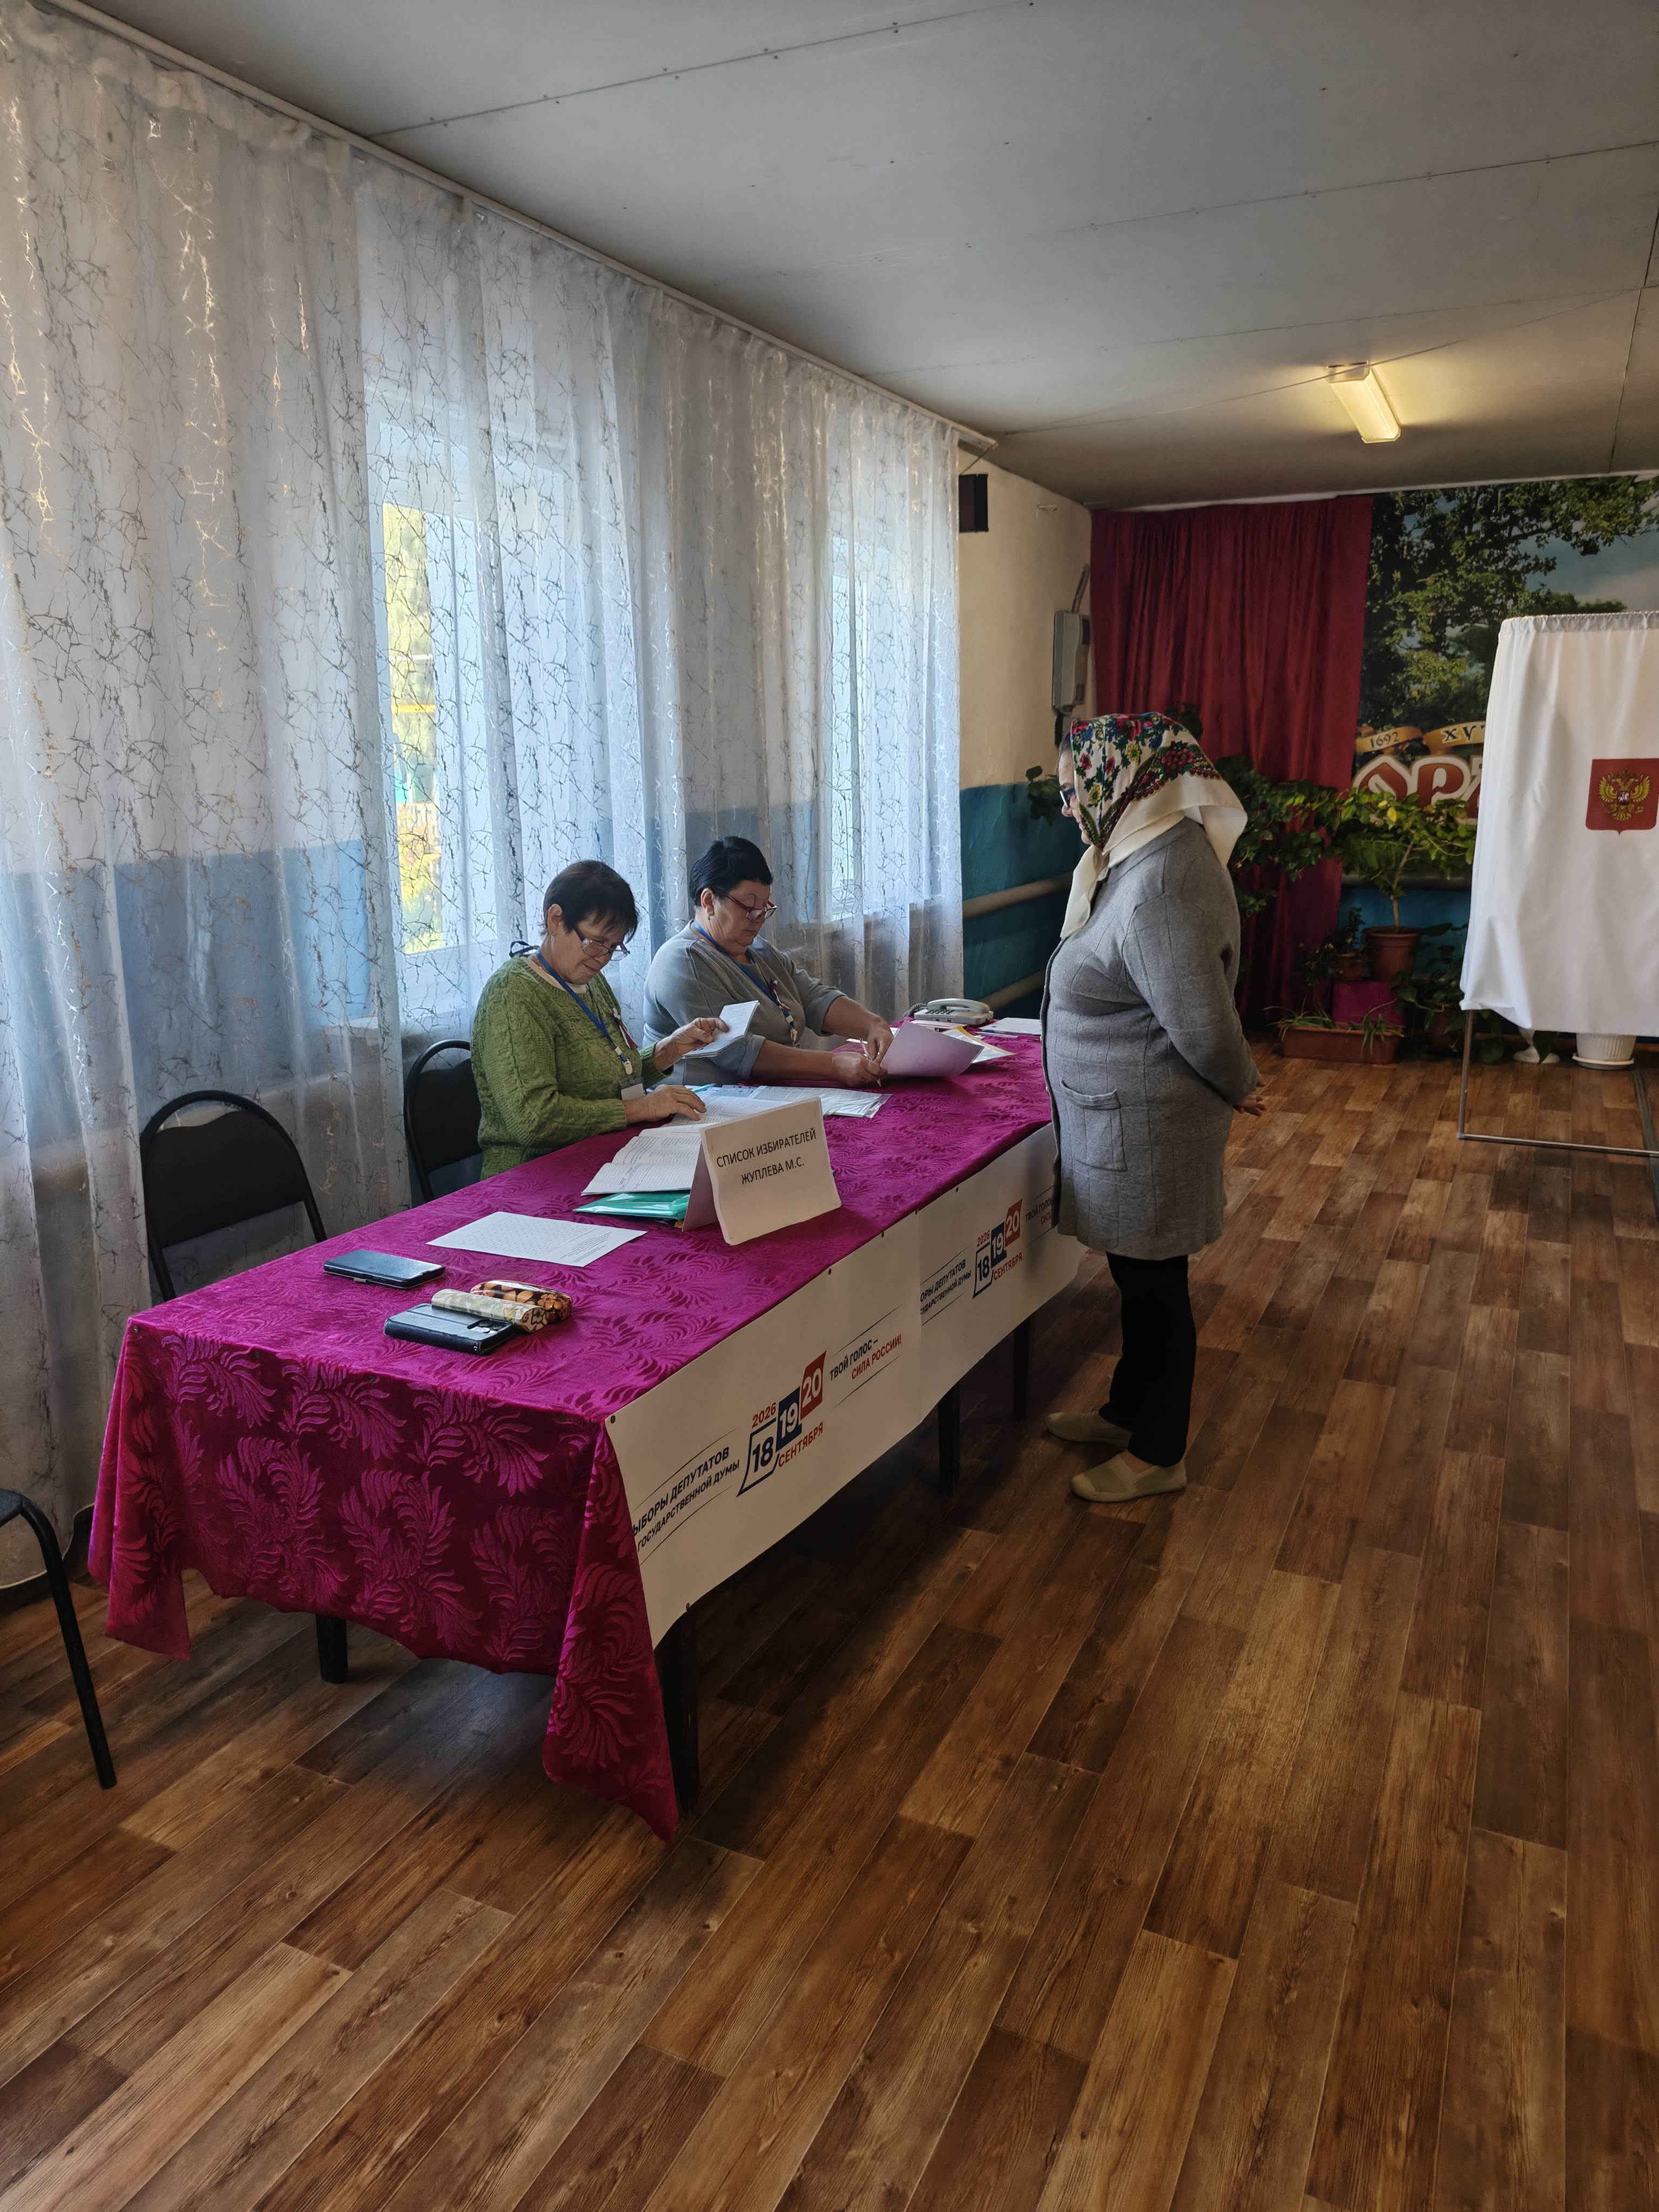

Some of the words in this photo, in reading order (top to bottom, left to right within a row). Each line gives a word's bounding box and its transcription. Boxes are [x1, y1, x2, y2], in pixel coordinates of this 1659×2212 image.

[1370, 731, 1400, 749] 1692
[1442, 726, 1485, 742] ХУ
[717, 1148, 755, 1168] СПИСОК
[756, 1127, 817, 1156] ИЗБИРАТЕЛЕЙ
[741, 1163, 784, 1185] ЖУПЛЕВА
[785, 1157, 805, 1171] М.С.
[1006, 1210, 1020, 1238] 20
[1026, 1205, 1038, 1223] ТВОЙ
[977, 1230, 990, 1247] 2026
[992, 1232, 1003, 1259] 19
[934, 1259, 966, 1293] ДЕПУТАТОВ
[958, 1270, 972, 1287] ДУМЫ
[977, 1255, 989, 1282] 18
[994, 1252, 1022, 1281] СЕНТЯБРЯ
[830, 1354, 848, 1381] ТВОЙ
[849, 1339, 872, 1366] ГОЛОС
[851, 1358, 871, 1380] СИЛА
[872, 1334, 901, 1365] РОССИИ!
[802, 1367, 822, 1408] 20
[752, 1402, 777, 1428] 2026
[779, 1402, 798, 1439] 19
[752, 1436, 774, 1473] 18
[778, 1421, 823, 1468] СЕНТЯБРЯ
[670, 1447, 730, 1504] ДЕПУТАТОВ
[638, 1475, 712, 1552] ГОСУДАРСТВЕННОЙ
[713, 1459, 740, 1485] ДУМЫ
